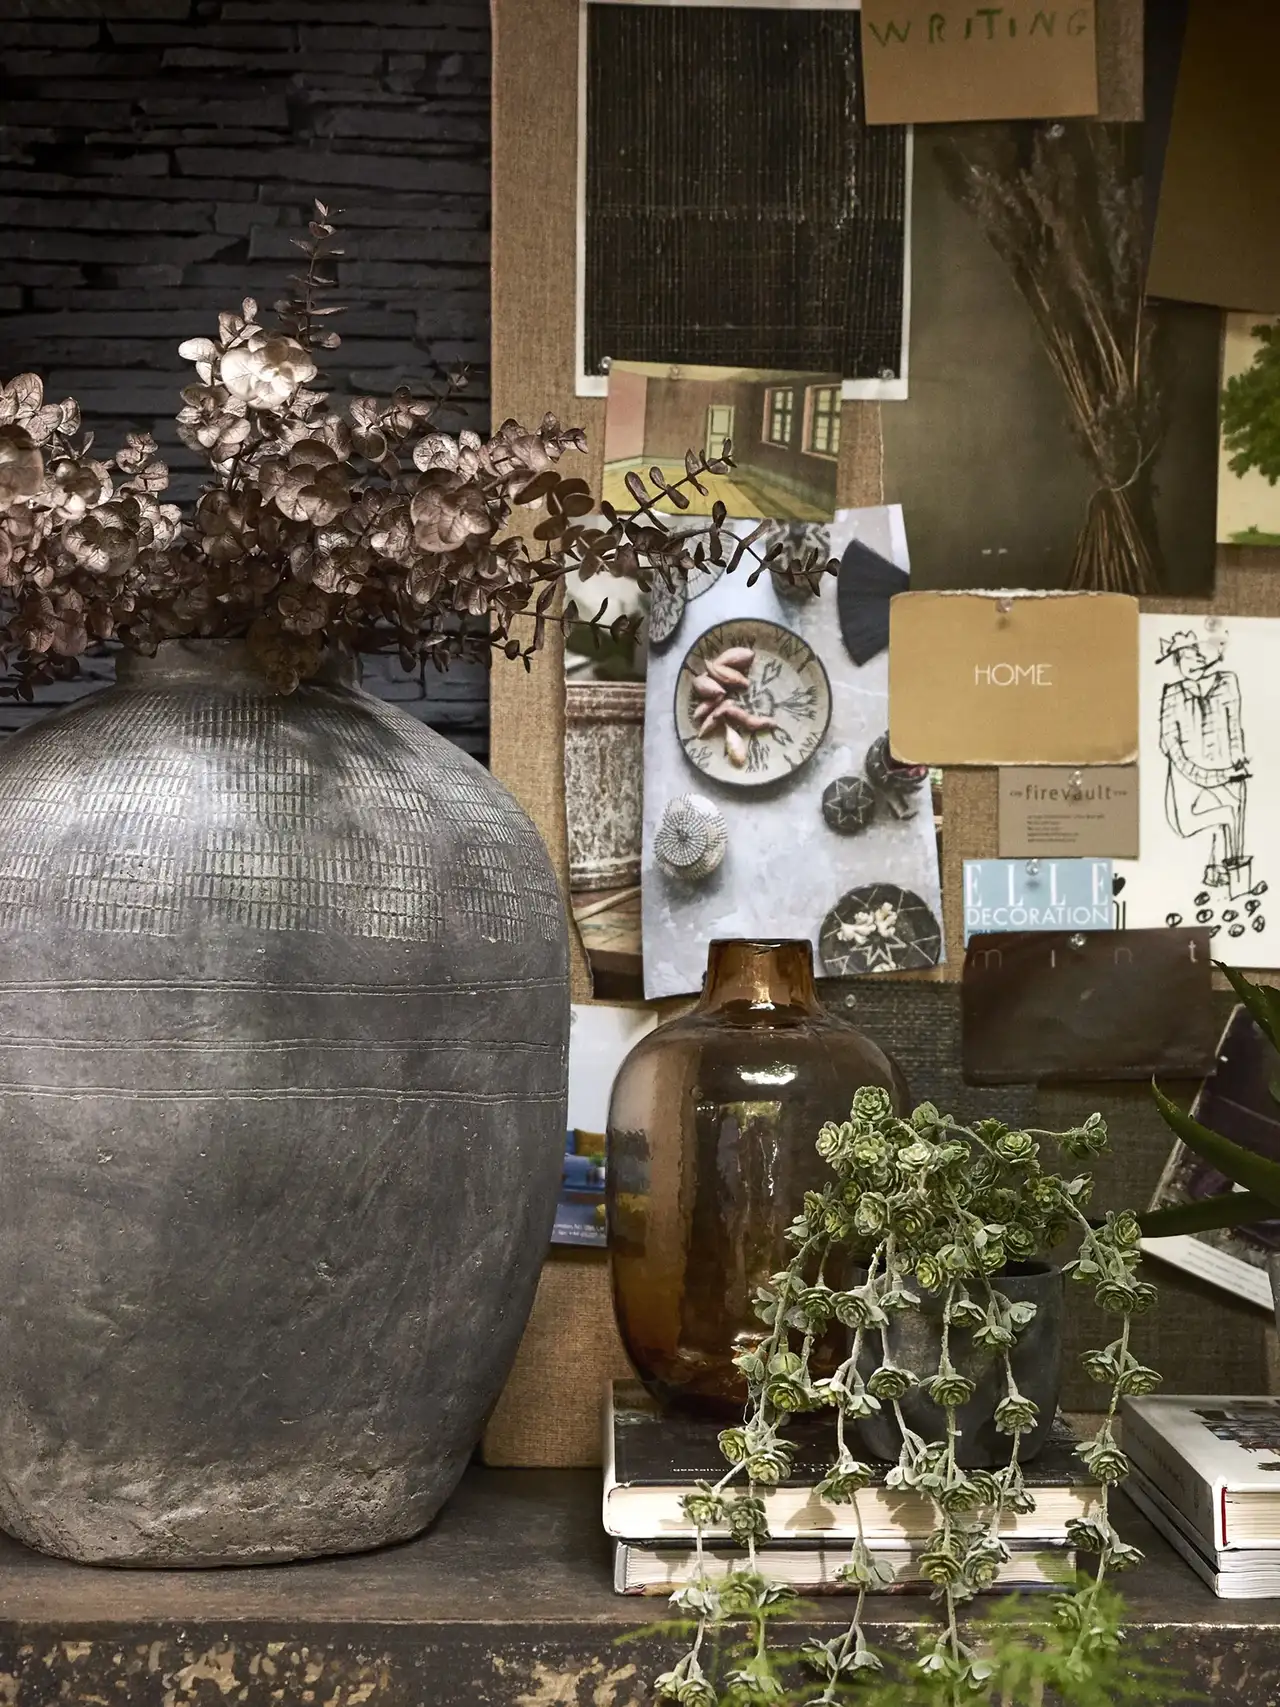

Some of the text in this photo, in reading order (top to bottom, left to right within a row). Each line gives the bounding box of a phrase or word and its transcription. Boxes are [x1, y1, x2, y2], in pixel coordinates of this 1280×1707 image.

[868, 9, 1087, 47] WRITING
[974, 663, 1053, 686] HOME
[1025, 784, 1112, 801] firevault
[964, 862, 1109, 907] ELLE
[966, 905, 1109, 926] DECORATION
[971, 939, 1198, 969] mint
